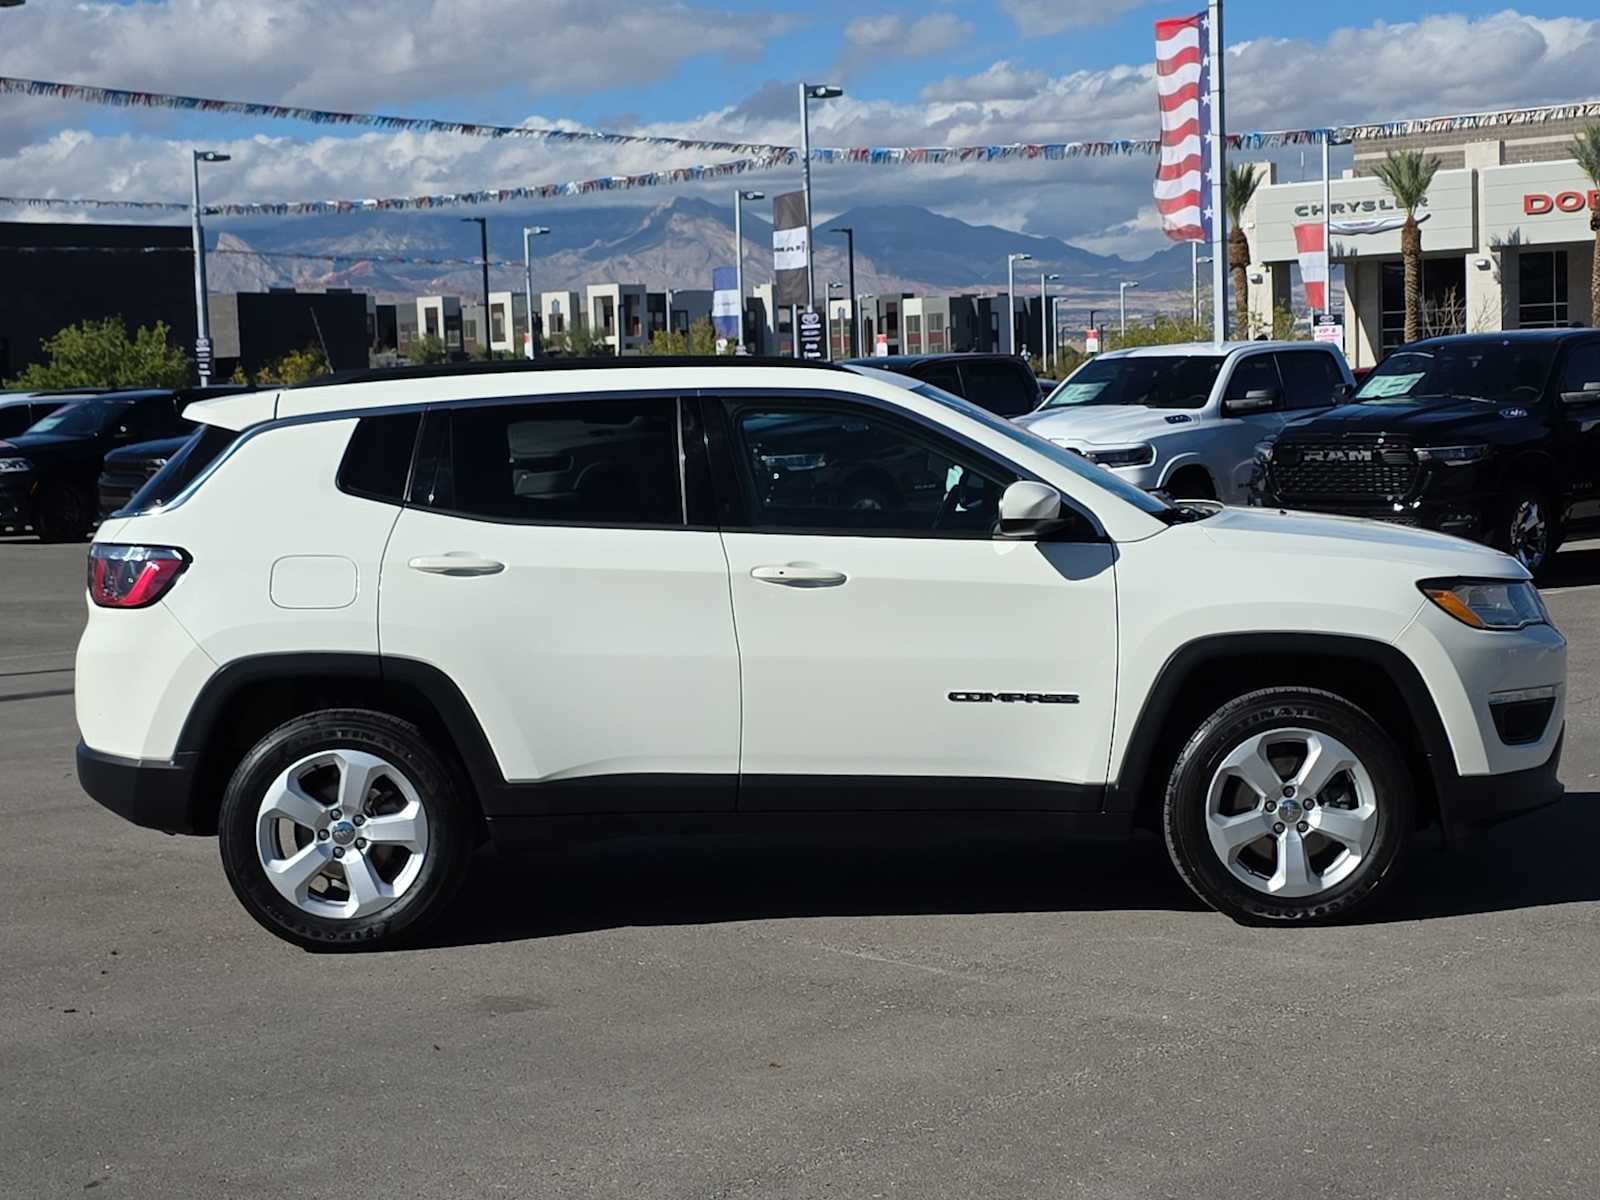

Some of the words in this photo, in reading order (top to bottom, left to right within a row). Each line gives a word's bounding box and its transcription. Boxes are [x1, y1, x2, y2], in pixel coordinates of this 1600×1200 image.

[1294, 197, 1429, 217] CHRYSLR
[1304, 450, 1372, 461] RAM
[948, 692, 1080, 704] COMPASS
